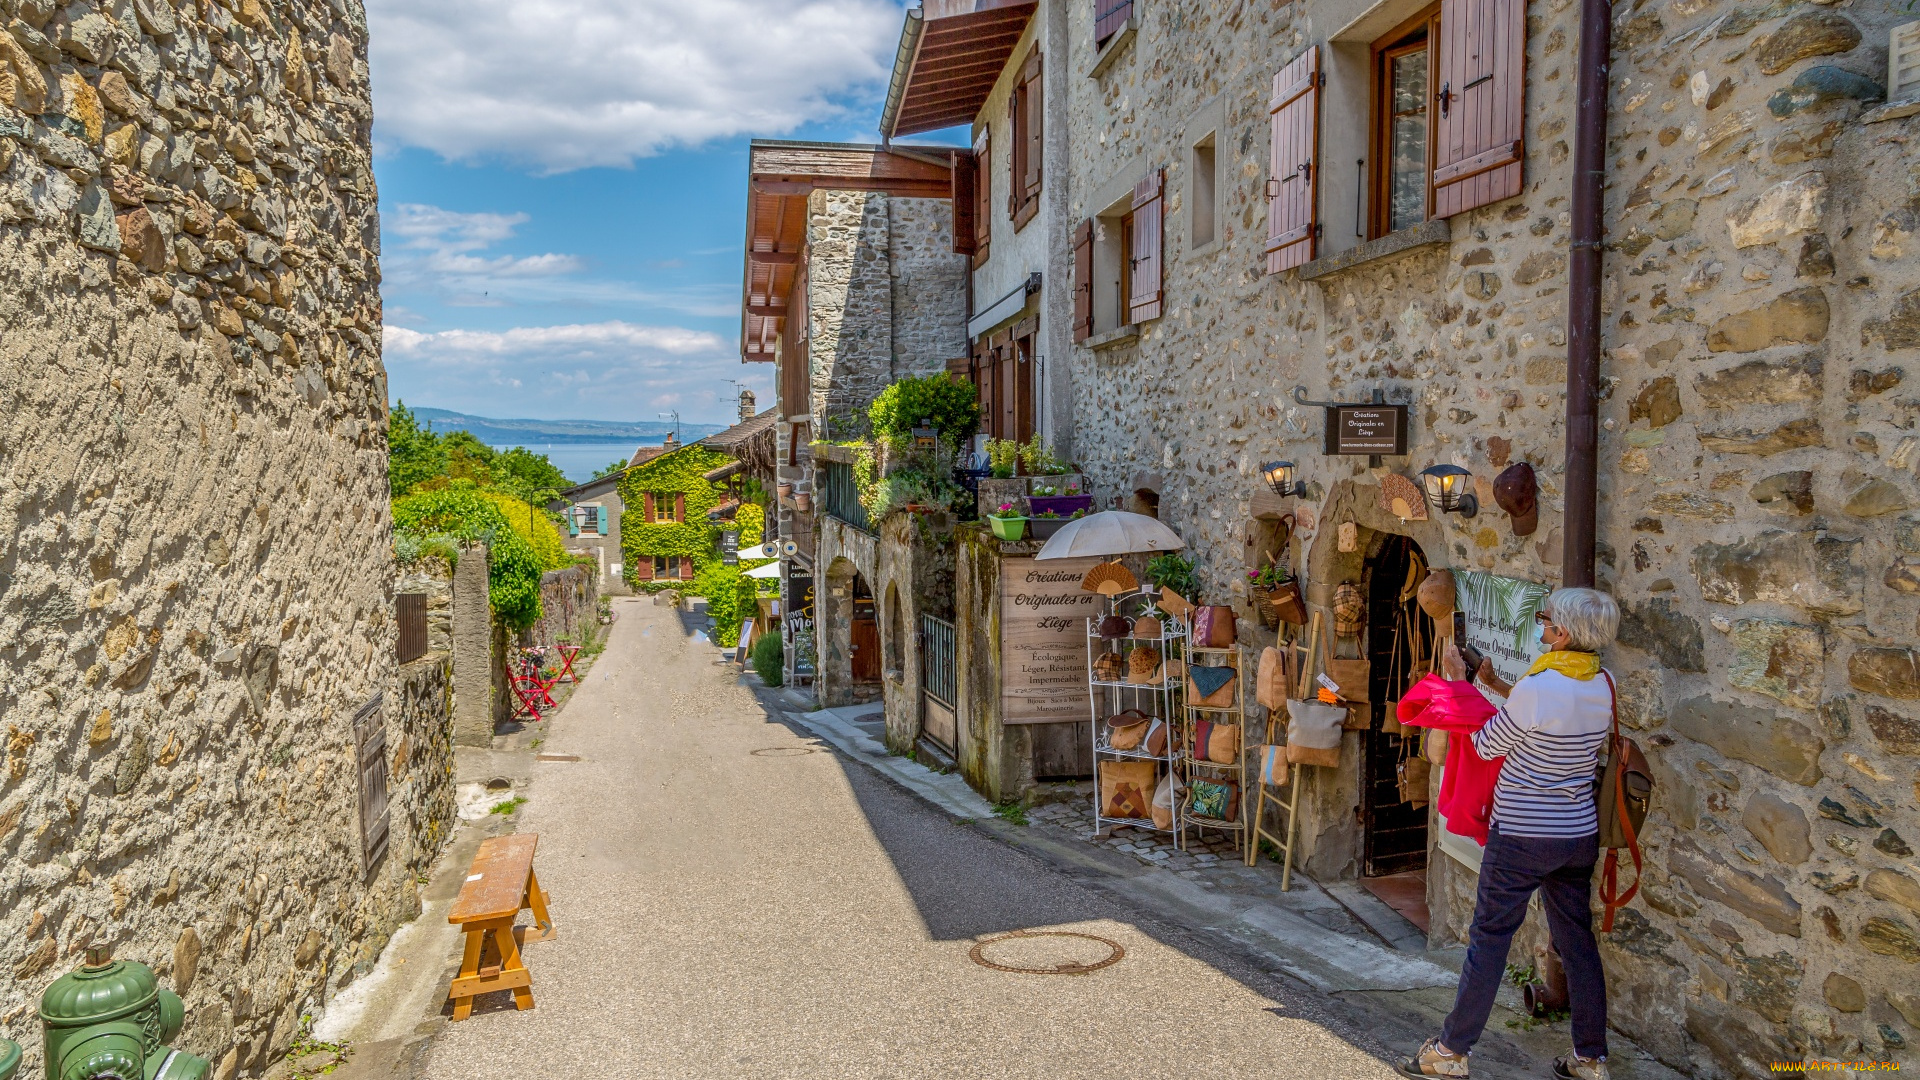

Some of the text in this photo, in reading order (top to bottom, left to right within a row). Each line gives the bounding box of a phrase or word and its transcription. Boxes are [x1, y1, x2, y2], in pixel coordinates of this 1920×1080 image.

[1348, 420, 1376, 428] Originales
[1025, 570, 1083, 583] Créations
[1014, 593, 1093, 610] Originales en
[1036, 615, 1073, 632] Liège
[1468, 610, 1486, 630] Liège
[1498, 617, 1519, 636] Cork
[1032, 650, 1078, 662] Écologique,
[1492, 638, 1531, 663] Originales
[1022, 664, 1088, 674] Léger, Résistant,
[1029, 674, 1081, 685] Imperméable
